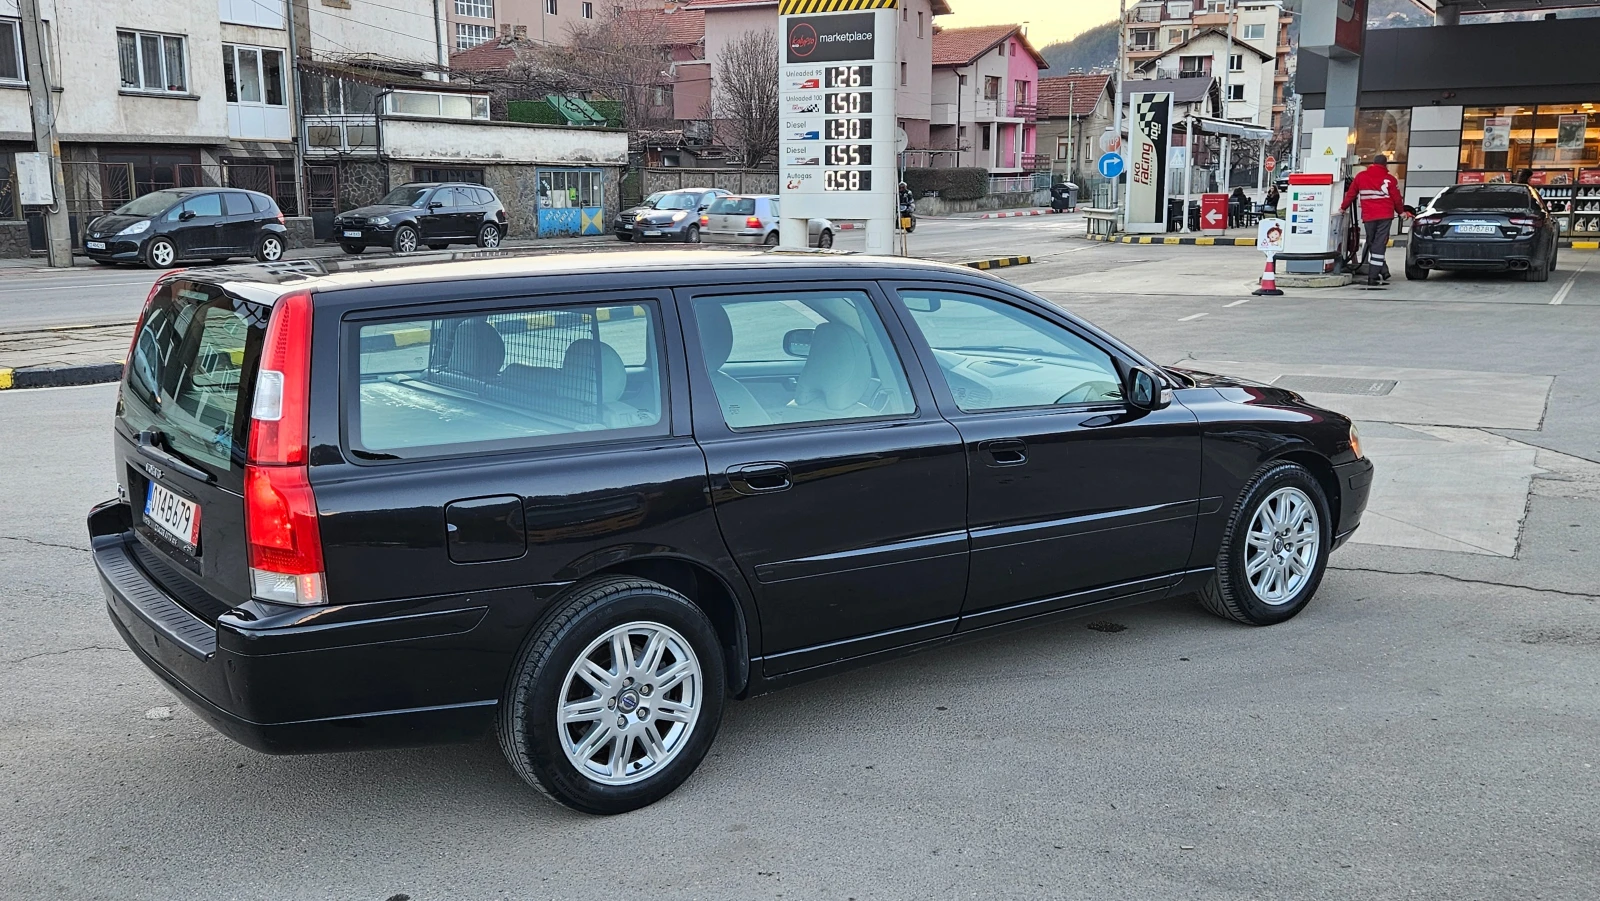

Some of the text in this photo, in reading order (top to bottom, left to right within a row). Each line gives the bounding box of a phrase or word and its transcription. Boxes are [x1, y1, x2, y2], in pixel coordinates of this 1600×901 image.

[820, 31, 872, 43] marketplace
[832, 66, 860, 87] 1.26
[832, 92, 860, 113] 1.50
[831, 118, 860, 139] 1.30
[1150, 121, 1158, 140] 100
[831, 144, 860, 166] 1.55
[1140, 142, 1154, 185] racing
[824, 170, 860, 190] 0.58
[152, 485, 191, 534] 014B679
